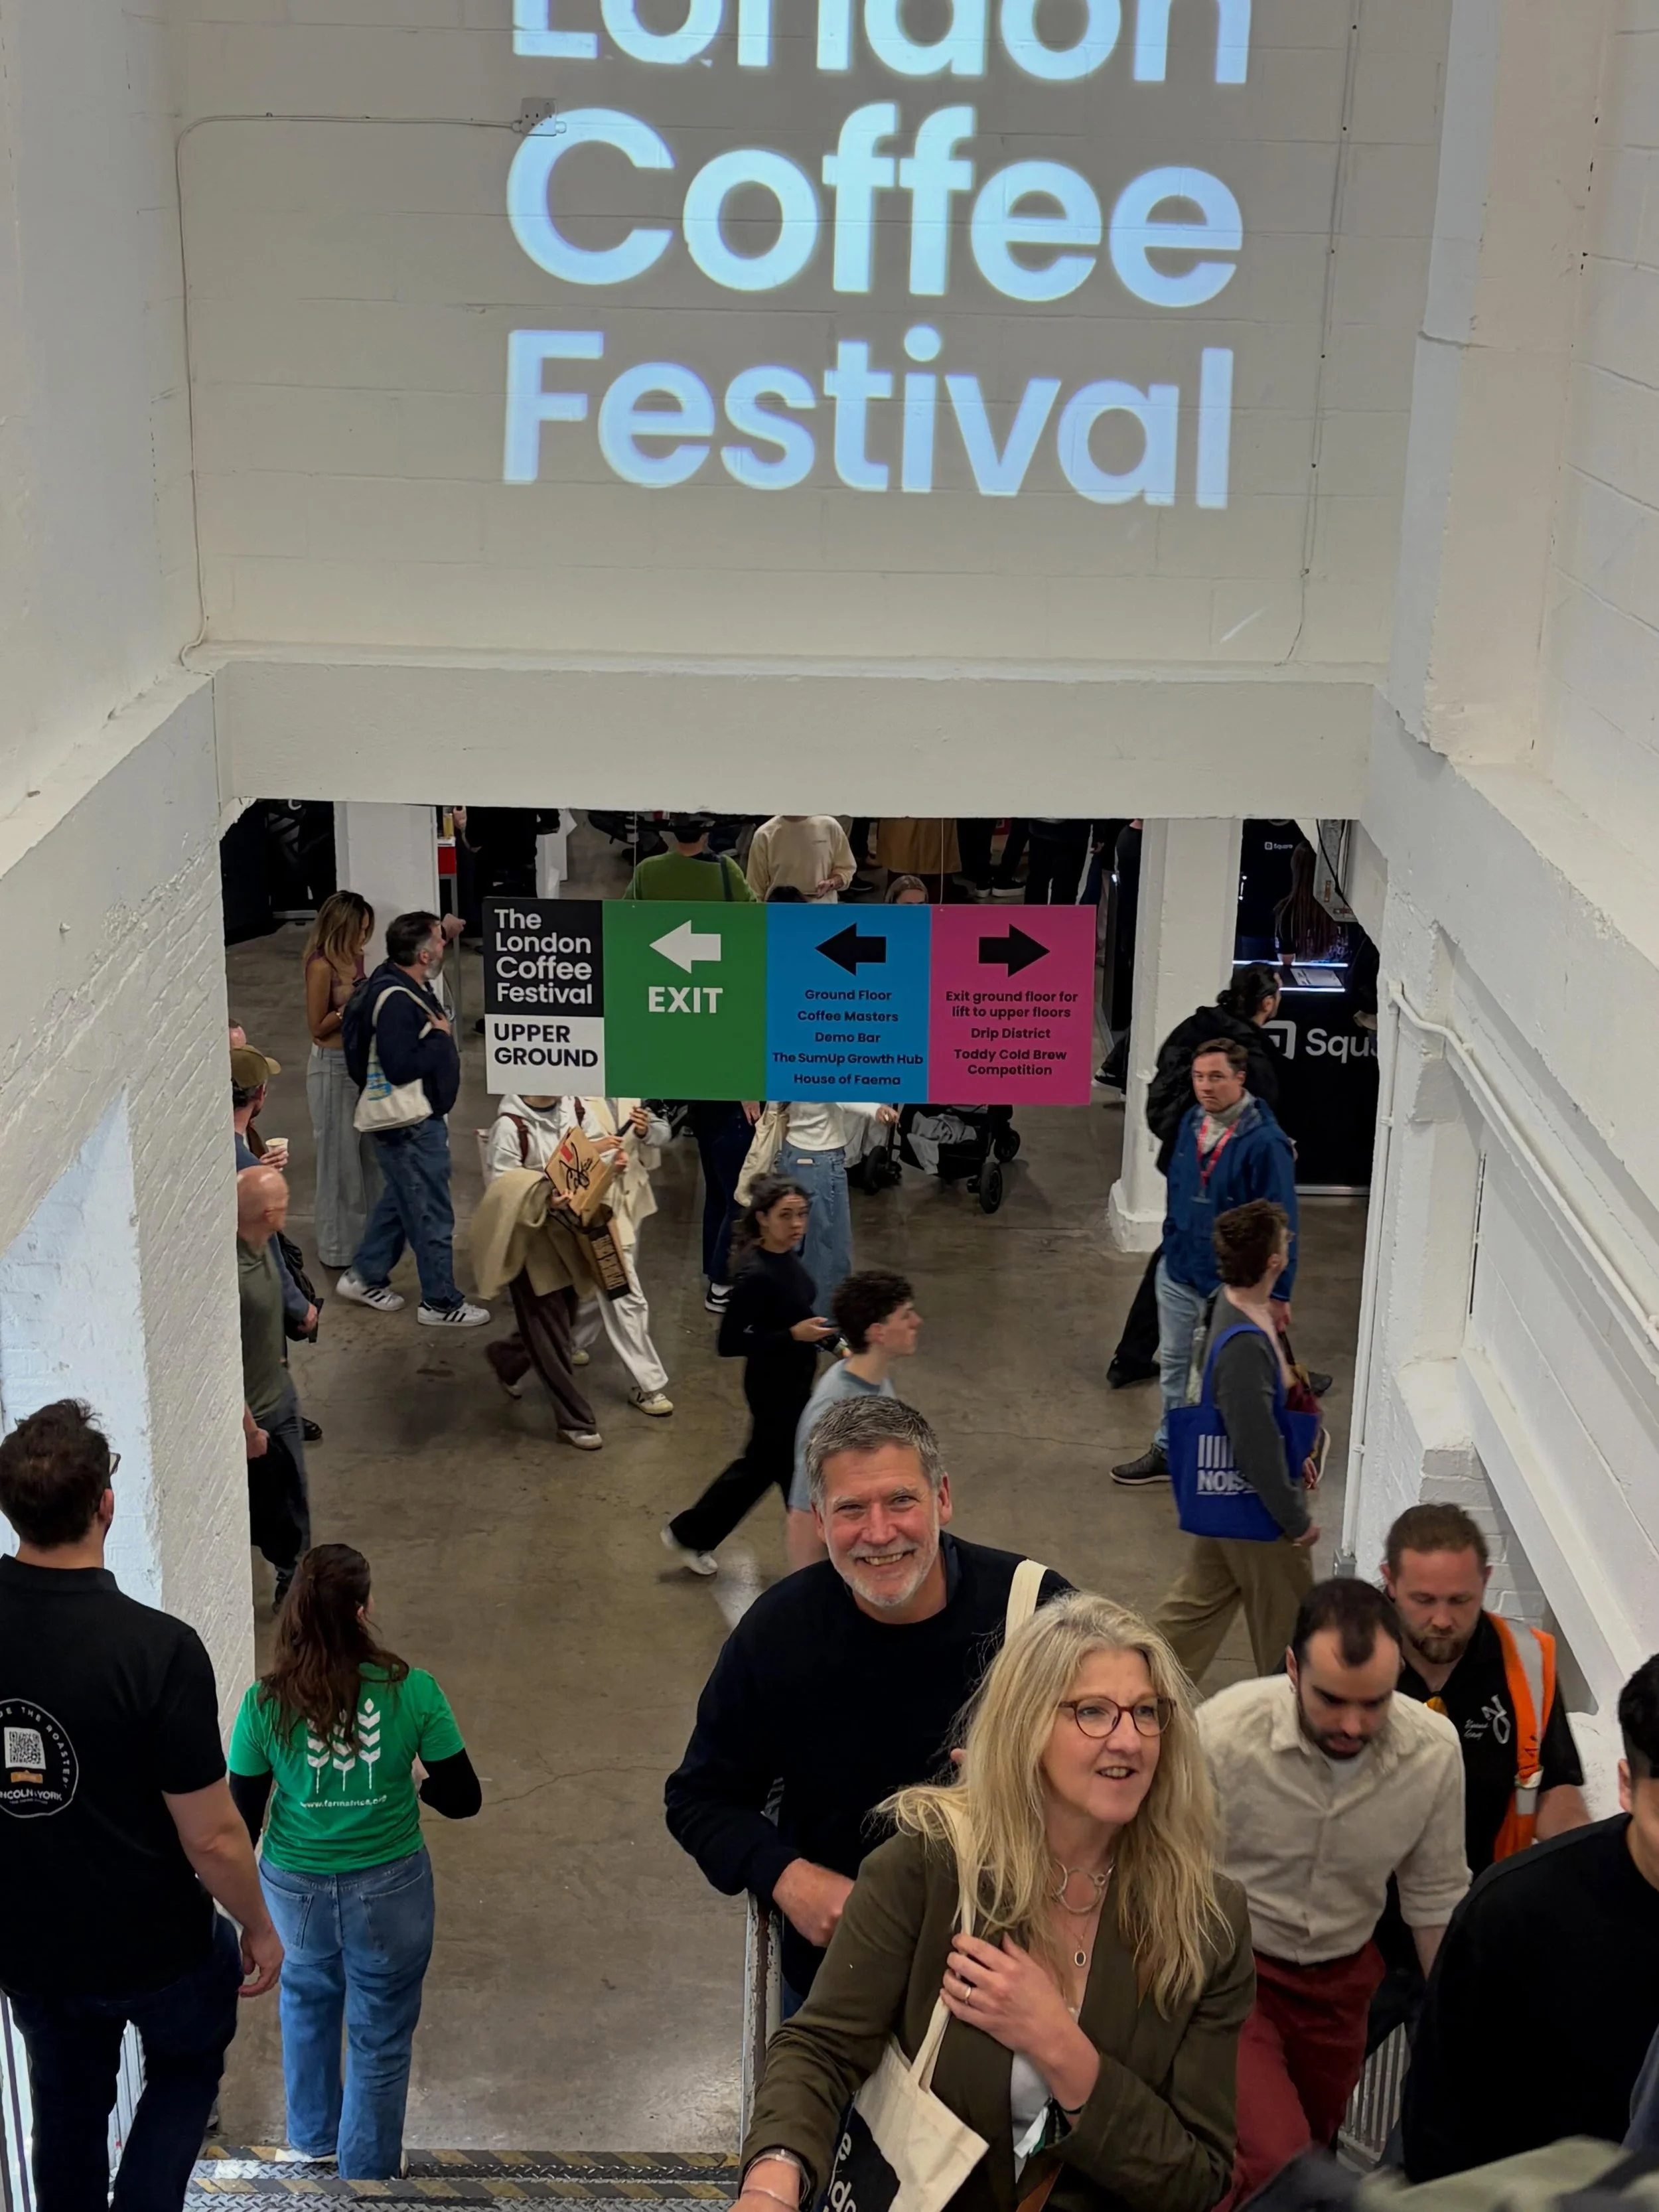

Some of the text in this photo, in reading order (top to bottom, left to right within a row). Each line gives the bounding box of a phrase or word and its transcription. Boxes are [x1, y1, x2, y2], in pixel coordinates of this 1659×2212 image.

[506, 102, 1242, 307] Coffee
[502, 324, 1234, 510] Festival
[494, 909, 541, 930] The
[496, 932, 591, 954] London
[496, 955, 592, 980] Coffee
[497, 982, 593, 1004] Festival
[648, 986, 723, 1014] EXIT
[805, 990, 892, 1000] Ground Floor
[946, 991, 1078, 1004] Exit ground floor for
[798, 1011, 899, 1022] Coffee Masters
[952, 1006, 1071, 1020] lift to upper floors
[494, 1023, 571, 1043] UPPER
[815, 1032, 881, 1043] Demo Bar
[972, 1027, 1050, 1041] Drip District
[1305, 1028, 1377, 1064] Squ
[494, 1047, 599, 1067] GROUND
[772, 1053, 923, 1067] The SumUp Growth Hub
[954, 1049, 1066, 1063] Toddy Cold Brew
[794, 1074, 901, 1085] House of Faema
[968, 1064, 1052, 1078] Competition
